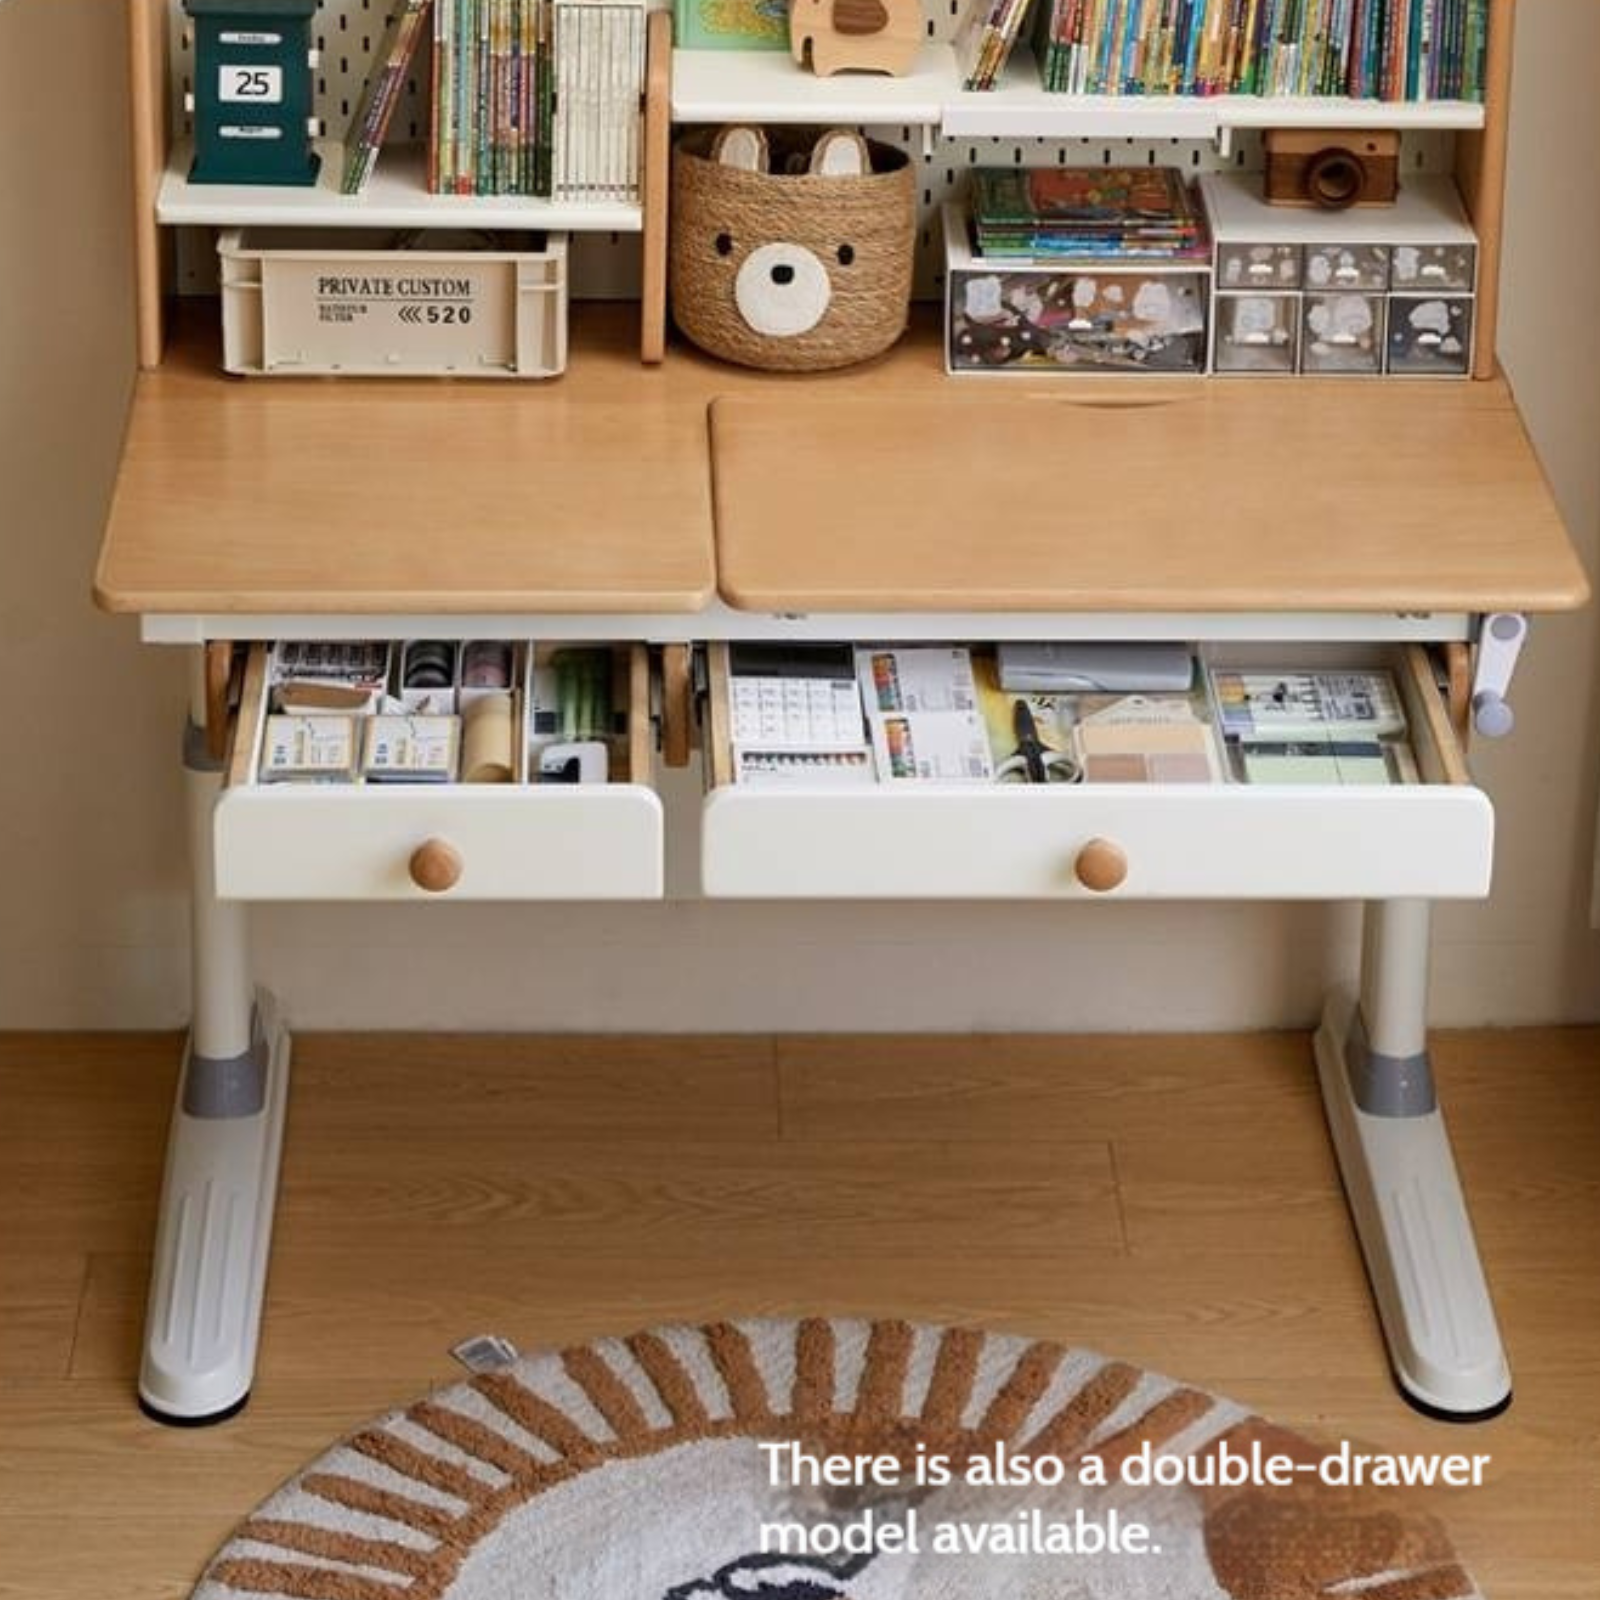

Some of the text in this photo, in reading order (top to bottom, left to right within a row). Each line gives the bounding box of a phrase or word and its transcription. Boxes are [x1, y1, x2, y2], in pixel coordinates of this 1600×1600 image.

[235, 71, 270, 96] 25
[318, 277, 470, 296] PRIVATE CUSTOM
[427, 305, 471, 324] 520
